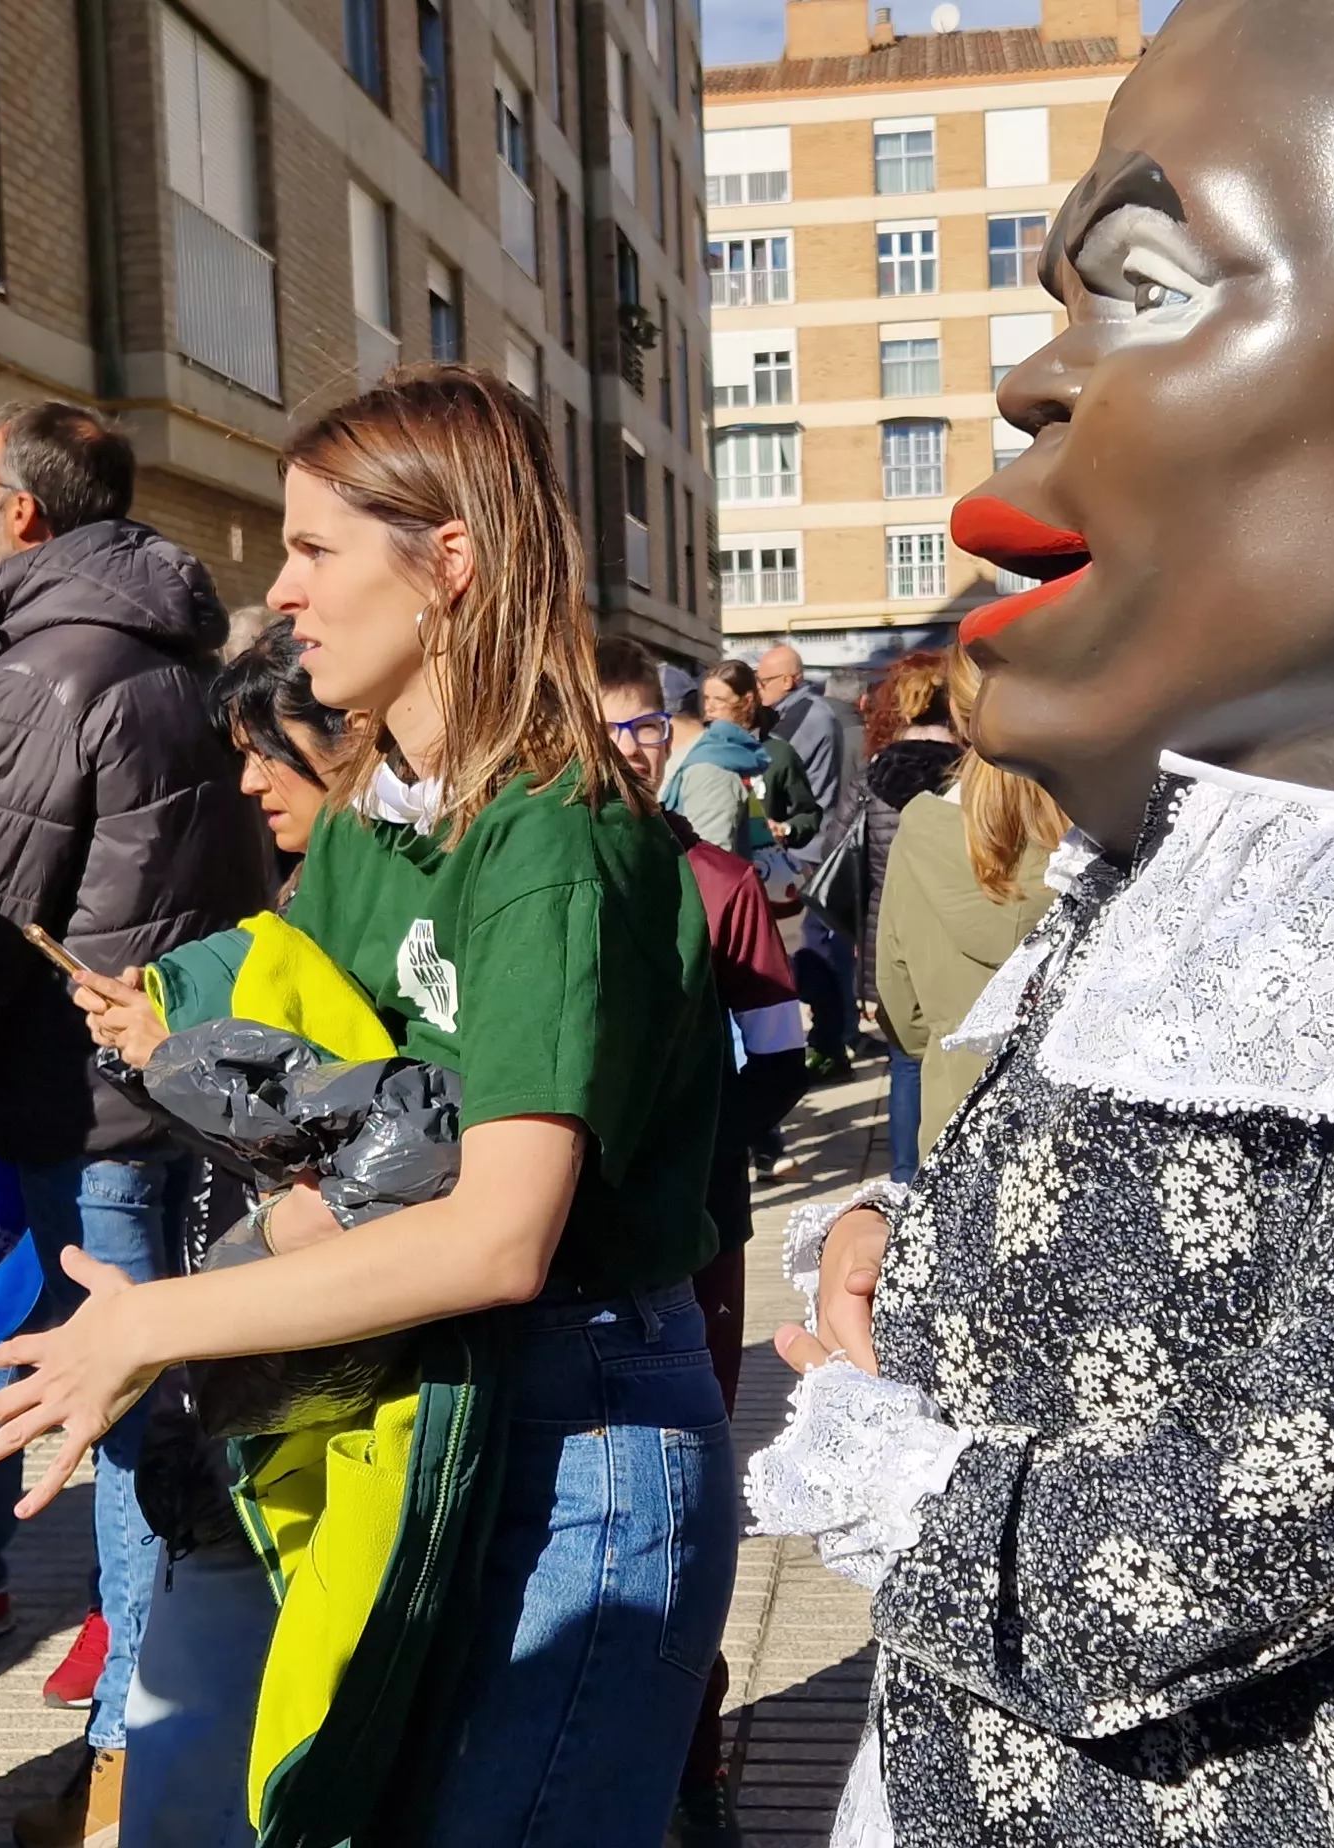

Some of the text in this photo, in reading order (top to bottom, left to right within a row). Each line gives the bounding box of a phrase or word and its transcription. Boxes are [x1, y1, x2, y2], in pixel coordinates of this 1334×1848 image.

[408, 940, 439, 966] SAN
[413, 965, 448, 985] MAR
[423, 985, 450, 1017] TIN
